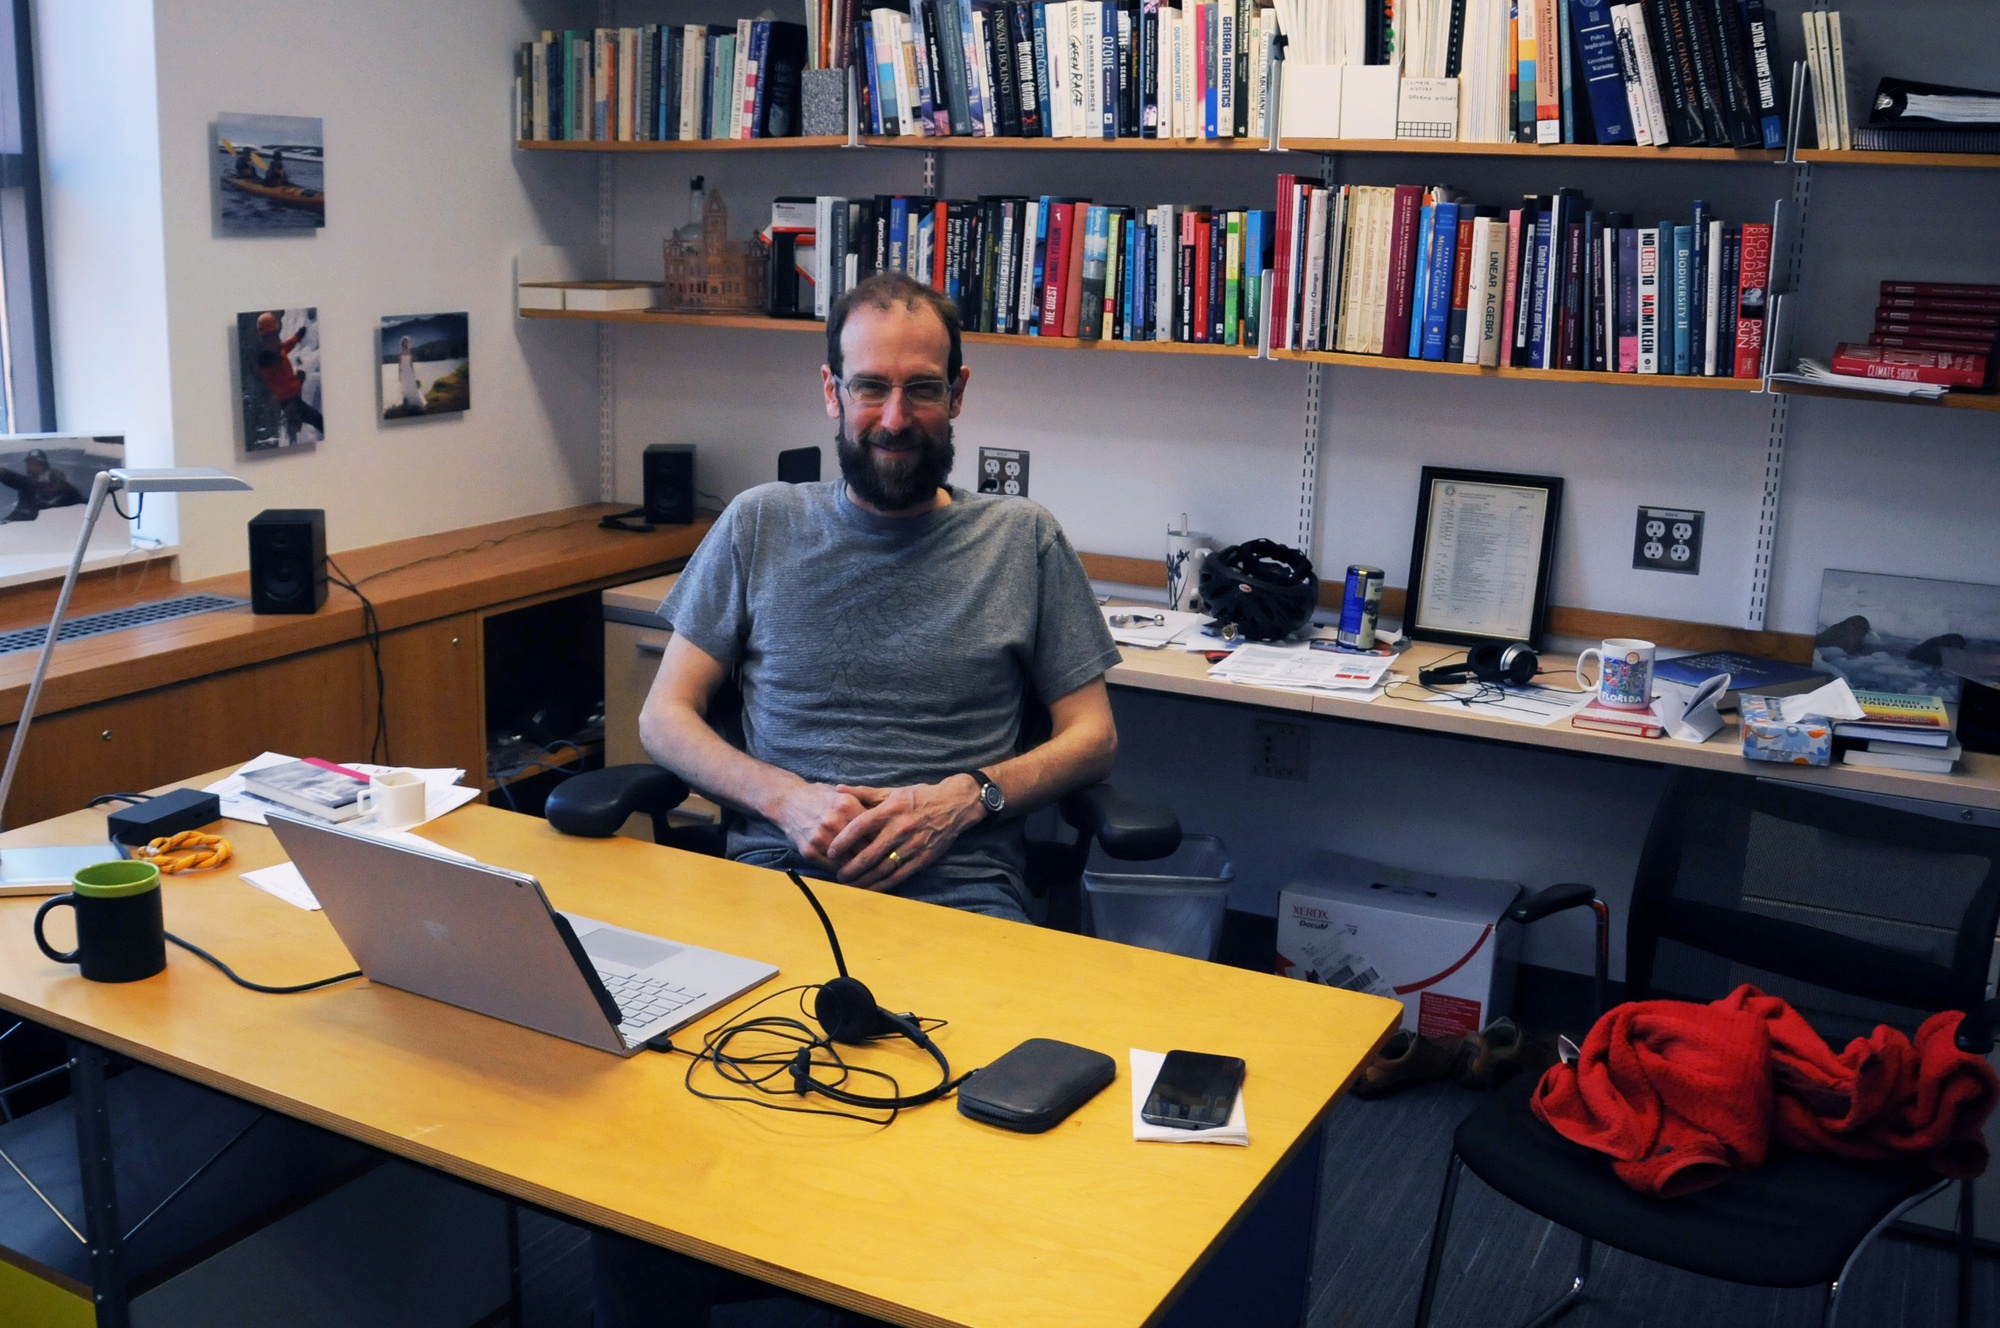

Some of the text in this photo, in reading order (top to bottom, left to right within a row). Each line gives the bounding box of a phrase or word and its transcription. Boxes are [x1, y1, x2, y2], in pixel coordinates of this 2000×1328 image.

[1117, 10, 1128, 48] EARTH:
[1546, 16, 1554, 42] Systems
[1590, 33, 1605, 41] Policy
[1657, 0, 1665, 15] THE
[1661, 17, 1672, 53] PHYSICAL
[1668, 55, 1678, 86] SCIENCE
[1750, 22, 1764, 47] POLICY
[995, 10, 1010, 93] INWARD BOUND
[1034, 28, 1048, 101] FORGED CONSENSUS
[1069, 35, 1082, 70] GREEN
[1102, 36, 1114, 70] OZONE
[1221, 16, 1232, 108] GENERAL ENERGETICS
[1587, 55, 1615, 64] Greenhouse
[1685, 1, 1710, 110] MITIGATION OF CLIMATE CHANGE
[1754, 49, 1770, 77] CHANGE
[1017, 42, 1035, 110] UNCOMMON GROUND
[1071, 73, 1083, 107] RAGE
[1547, 56, 1555, 98] Sustainability
[1678, 42, 1697, 106] CHANGE 2007
[1726, 72, 1736, 112] VULNERABILITY
[1759, 79, 1774, 108] CLIMATE
[875, 217, 886, 268] Dangerously
[892, 258, 902, 266] We
[953, 235, 961, 253] Many
[1048, 227, 1061, 282] DANIEL YERGIN
[1742, 227, 1757, 288] RHODES
[1754, 227, 1769, 288] RICHARD
[952, 255, 960, 279] People
[1431, 235, 1445, 310] MODERN CHEMISTRY
[1455, 252, 1465, 305] Paleoclimatology
[1506, 227, 1518, 302] READINGS IN RISK
[1677, 249, 1689, 318] BIODIVERSITY
[1045, 285, 1057, 325] THE QUEST
[1309, 272, 1319, 336] Elements of Change
[1440, 291, 1445, 299] OF
[1484, 251, 1499, 341] LINEAR ALGEBRA
[1531, 245, 1548, 342] Climate Change Science and Policy
[1641, 233, 1655, 353] NO LOGO 10 NAOMI KLEIN
[1708, 296, 1713, 304] OF
[1720, 285, 1728, 332] ENVIRONMENT
[1729, 285, 1737, 333] ENVIRONMENT
[1737, 320, 1750, 348] SUN
[1749, 319, 1762, 350] DARK
[1867, 364, 1919, 381] CLIMATE SHOCK
[1602, 692, 1642, 703] FLORIDA
[1293, 905, 1329, 920] XEROX
